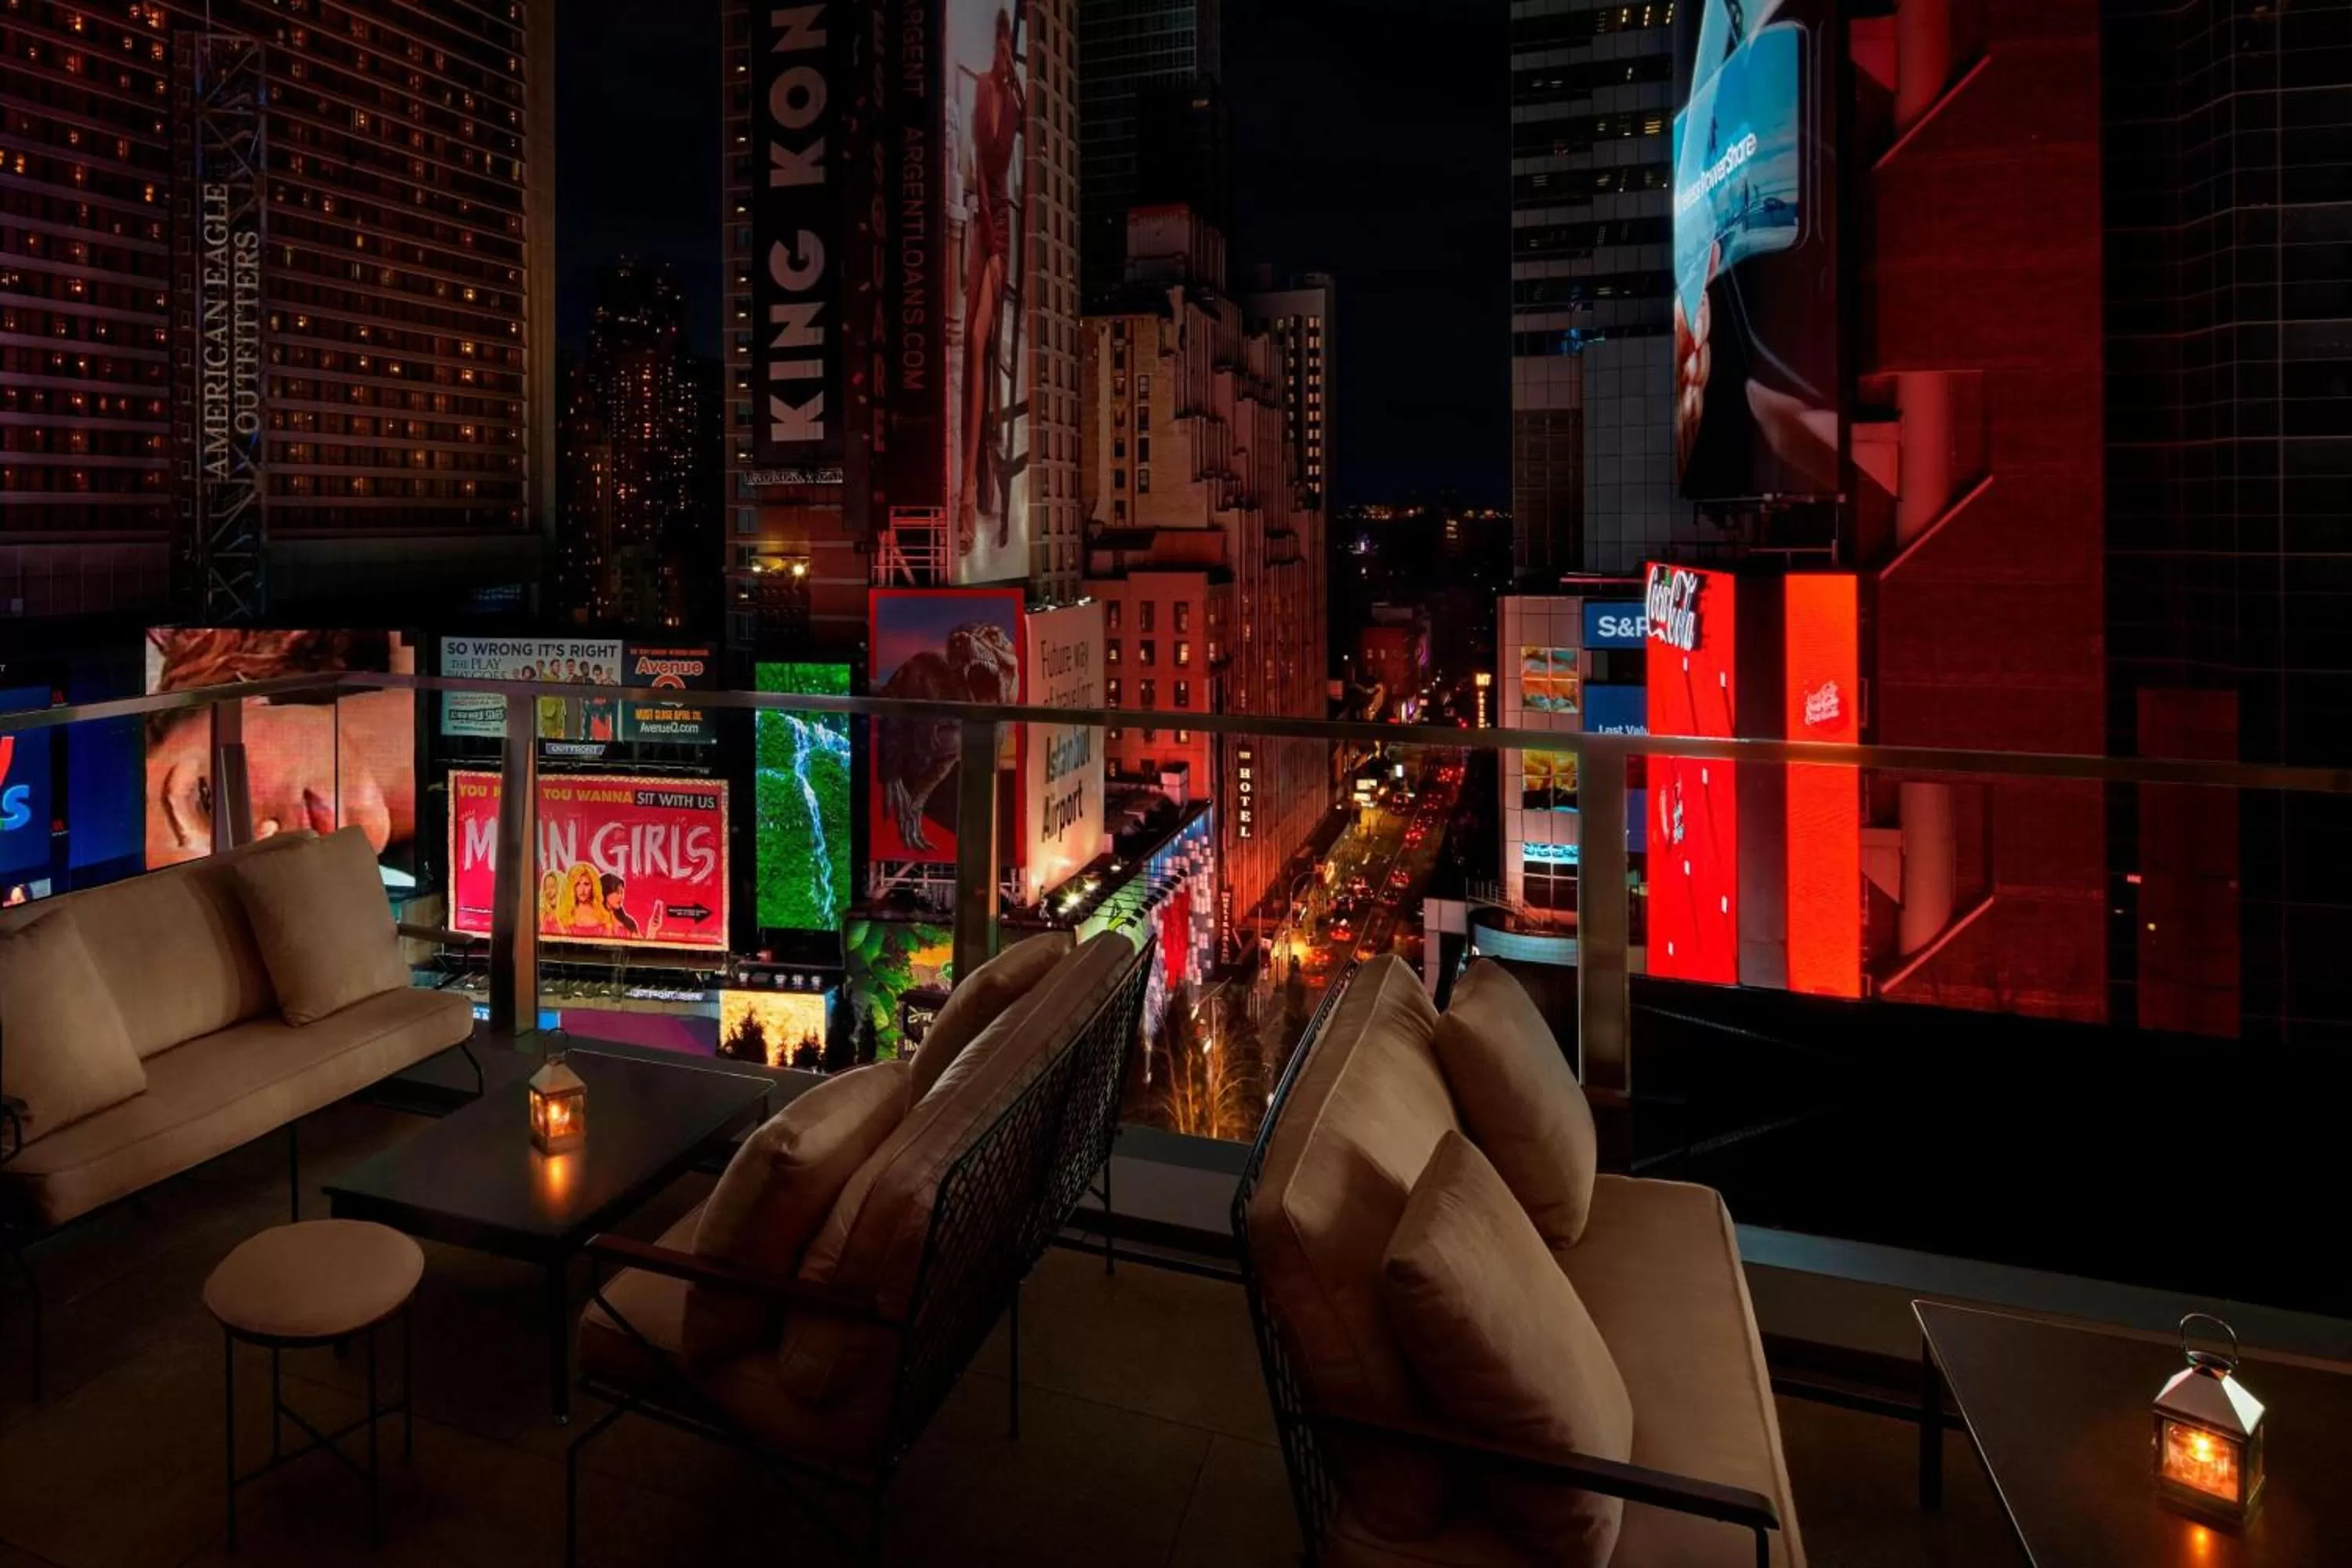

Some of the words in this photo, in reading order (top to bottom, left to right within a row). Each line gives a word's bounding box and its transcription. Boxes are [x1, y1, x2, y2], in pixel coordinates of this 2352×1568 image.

[767, 2, 829, 189] KON
[203, 183, 230, 288] EAGLE
[902, 125, 926, 390] ARGENTLOANS.COM
[234, 230, 260, 434] OUTFITTERS
[768, 229, 826, 443] KING
[203, 299, 230, 485] AMERICAN
[447, 642, 467, 656] SO
[472, 643, 532, 656] WRONG
[538, 644, 565, 657] IT'S
[570, 644, 618, 658] RIGHT
[452, 660, 467, 670] THE
[470, 658, 503, 670] PLAY
[635, 656, 704, 677] Avenue
[1040, 639, 1072, 681] Future
[1073, 640, 1089, 676] way
[639, 720, 699, 734] AvenueQ.com
[459, 784, 488, 798] YOU
[543, 787, 572, 800] YOU
[576, 789, 633, 804] WANNA
[636, 791, 655, 806] SIT
[659, 793, 694, 808] WITH
[698, 795, 716, 809] US
[1041, 779, 1084, 844] Airport
[1239, 767, 1252, 839] HOTEL
[590, 820, 717, 884] GIRLS
